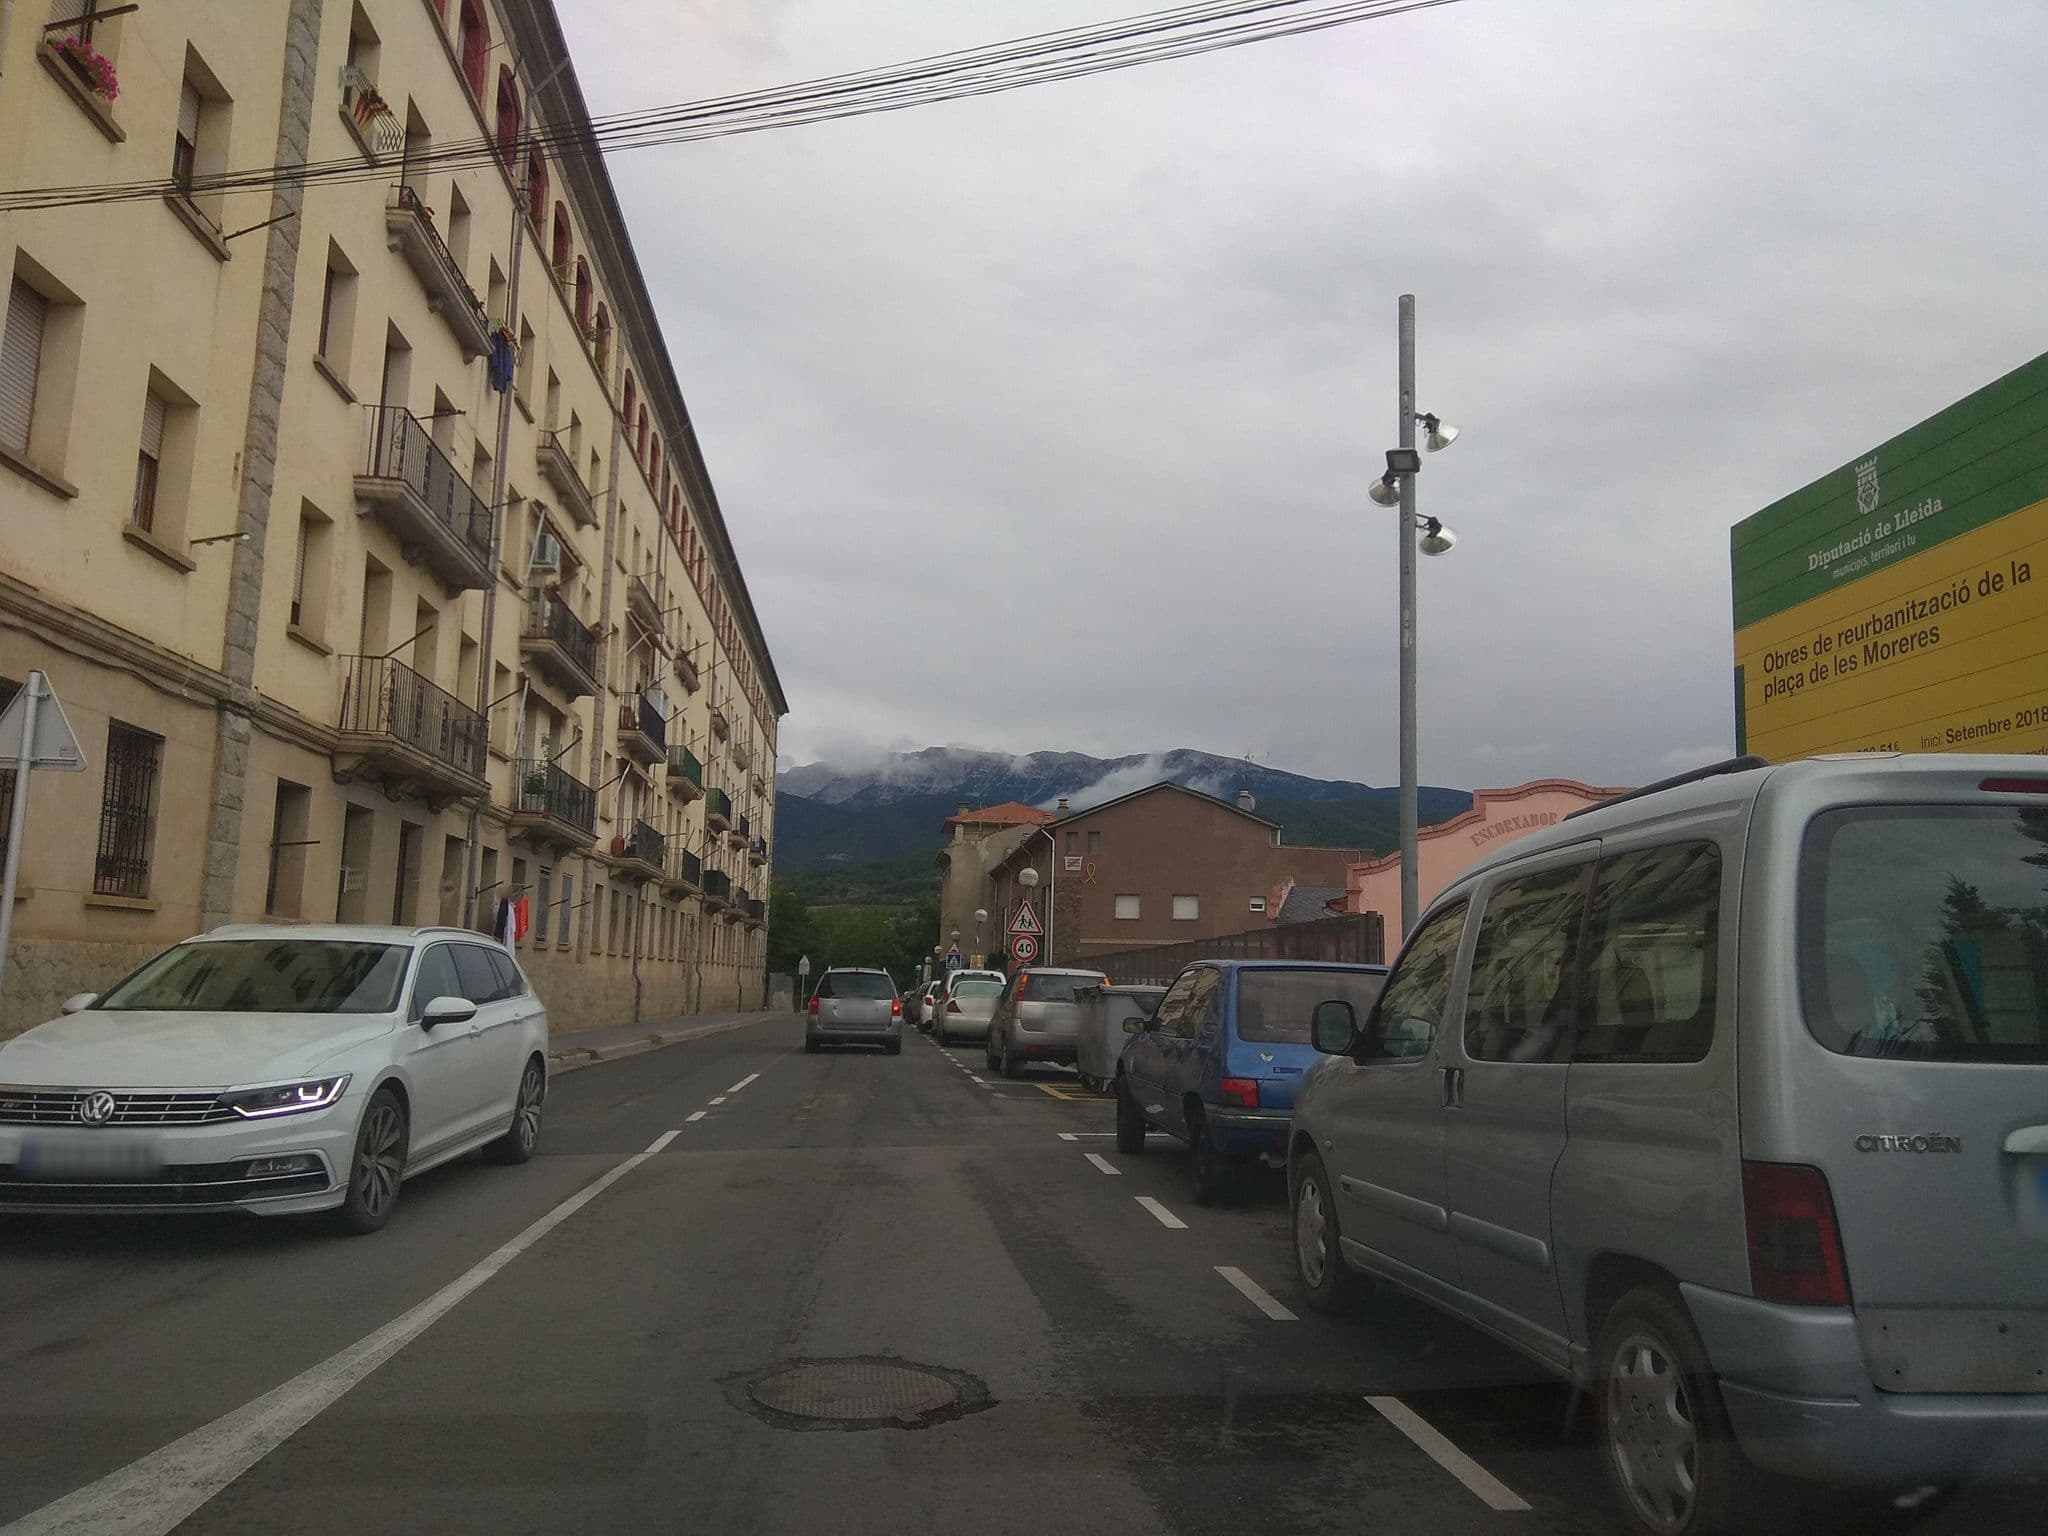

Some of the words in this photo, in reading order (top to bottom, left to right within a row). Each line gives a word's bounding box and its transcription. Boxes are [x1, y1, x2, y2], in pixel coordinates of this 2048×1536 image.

[1807, 527, 1872, 571] Diputació
[1874, 521, 1892, 540] de
[1893, 498, 1944, 531] Lleida
[1762, 643, 1808, 674] Obres
[1812, 634, 1833, 656] de
[1837, 578, 1971, 649] reurbanització
[1977, 570, 2004, 597] de
[2010, 560, 2032, 586] la
[1764, 671, 1804, 703] plaça
[1808, 661, 1829, 683] de
[1834, 652, 1858, 676] les
[1862, 625, 1941, 667] Moreres
[1945, 718, 2011, 744] Setembre
[2015, 704, 2048, 729] 2018
[1471, 812, 1558, 847] ESCORXADOR
[1017, 943, 1032, 954] 40
[1854, 1130, 1962, 1153] CITROËN
